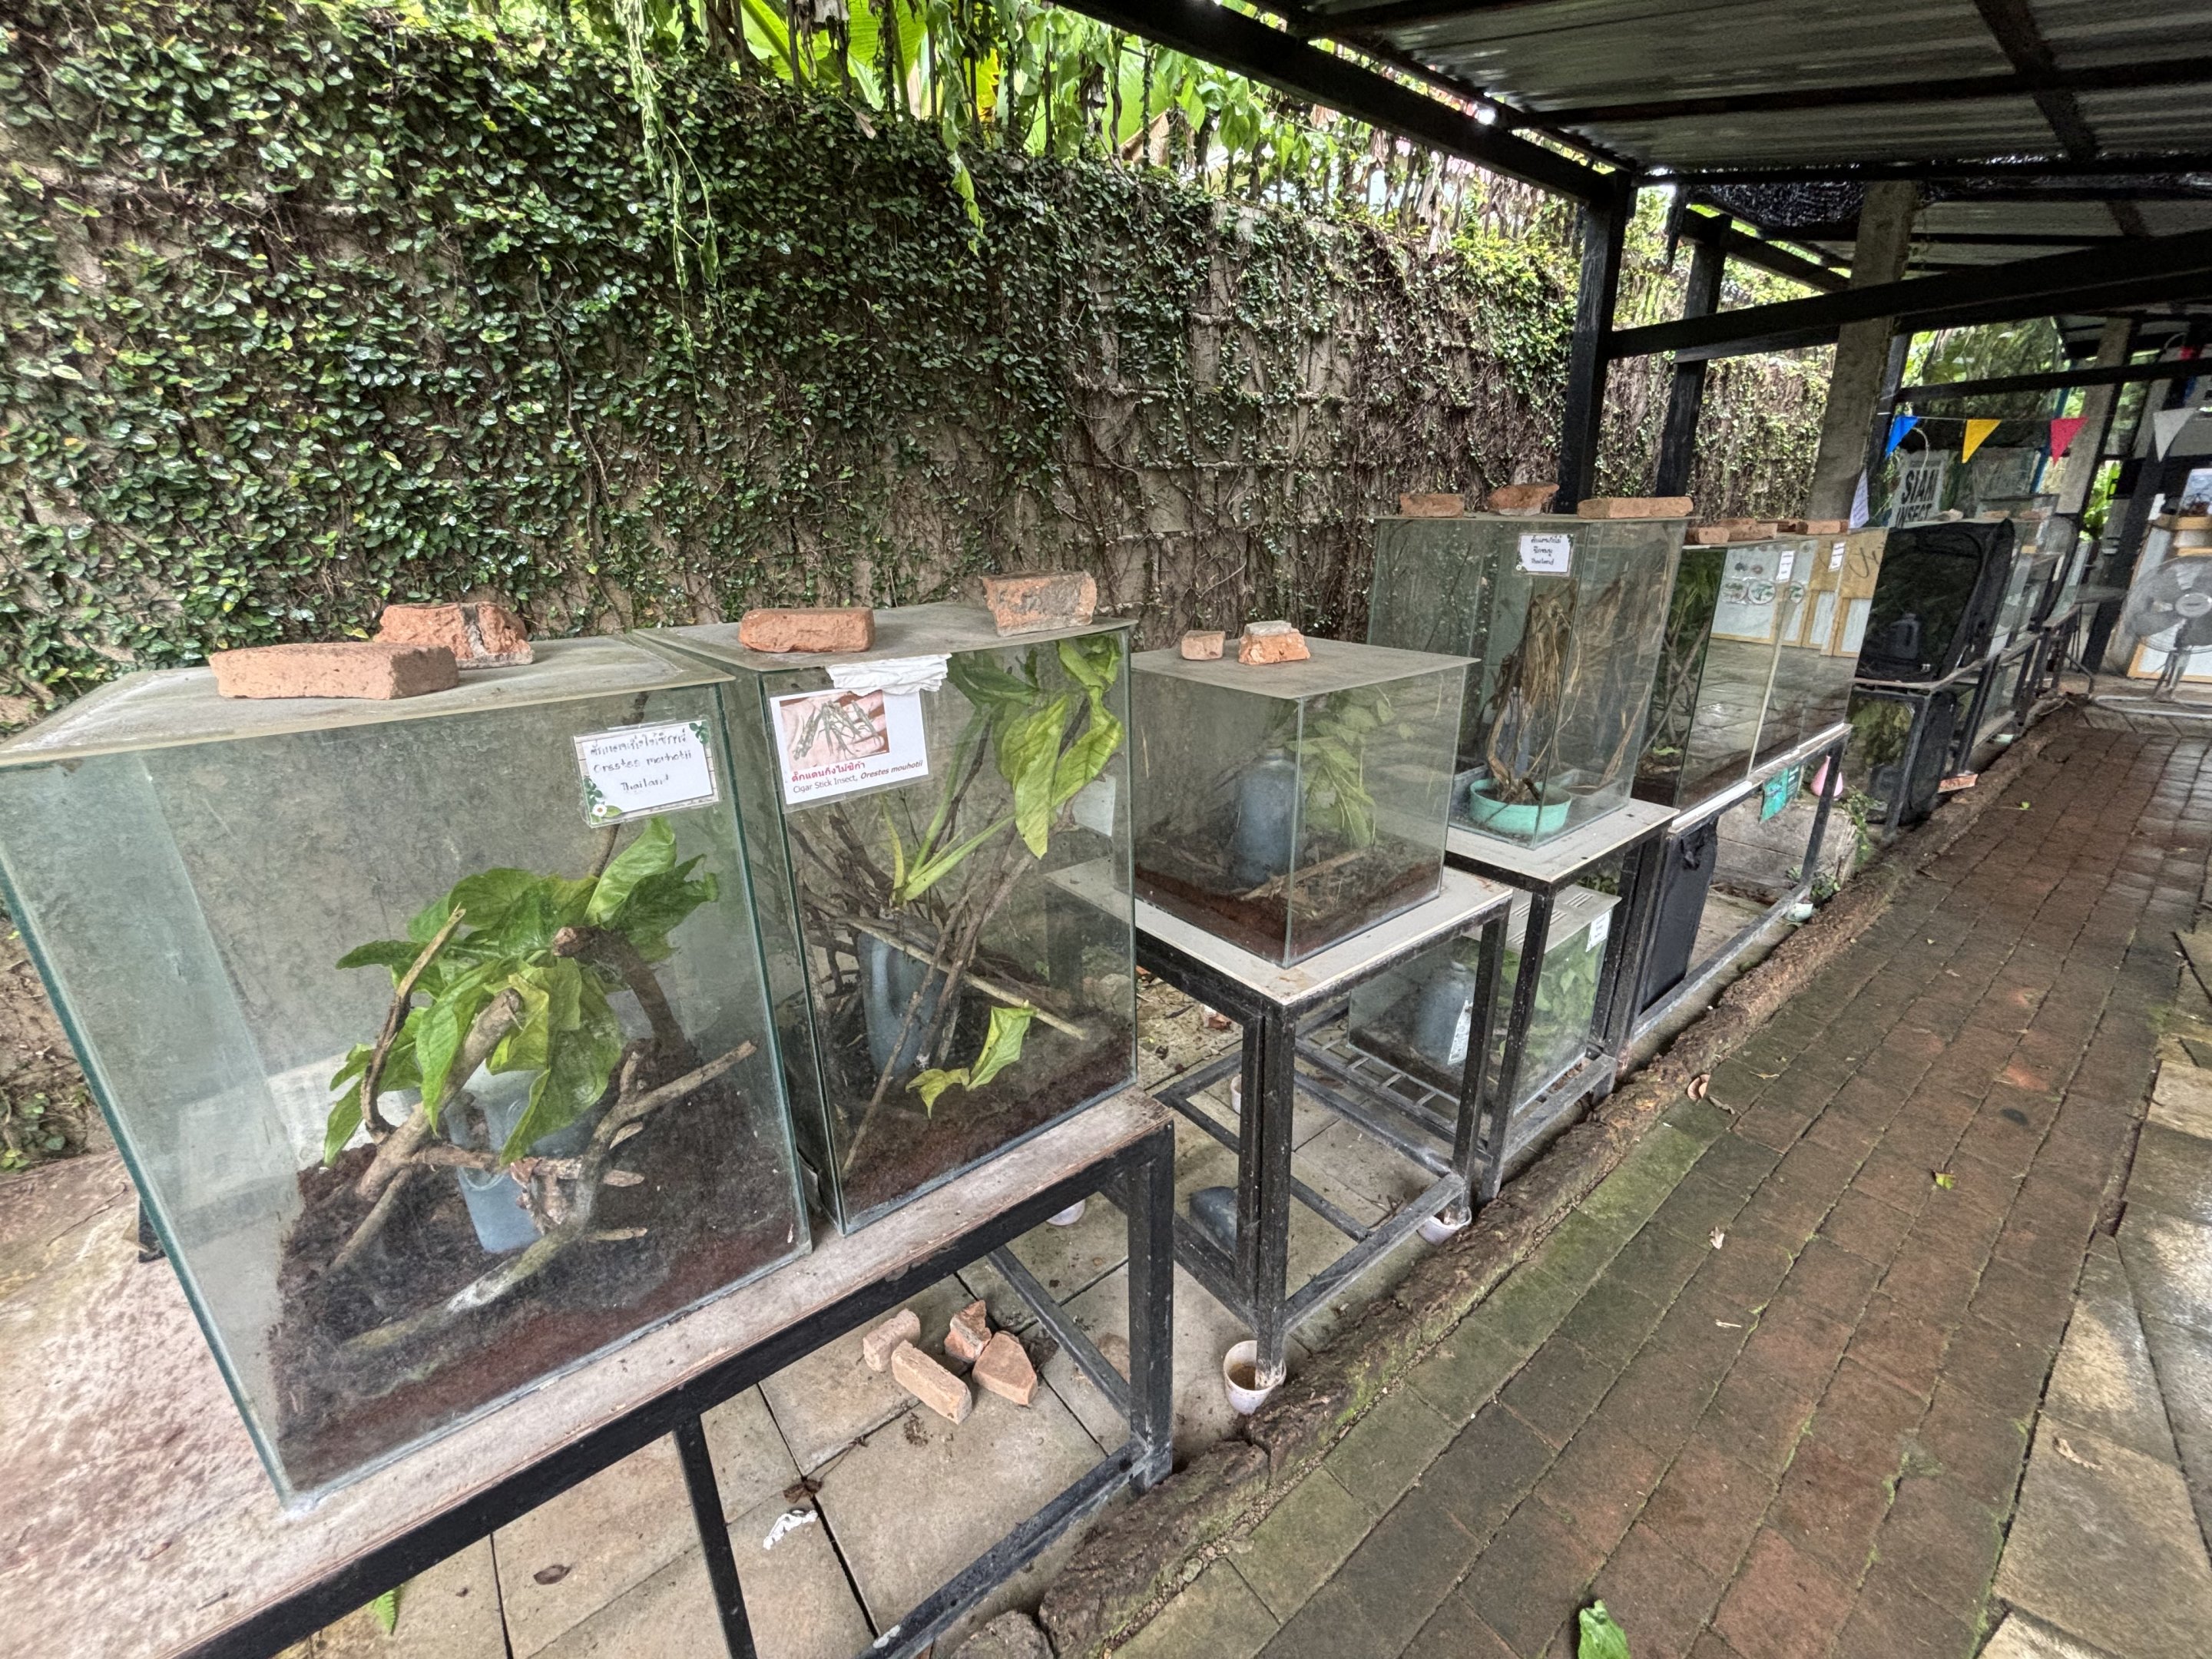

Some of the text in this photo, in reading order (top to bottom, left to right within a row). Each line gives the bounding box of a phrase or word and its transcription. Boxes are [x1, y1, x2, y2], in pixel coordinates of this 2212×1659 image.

[1901, 469, 1940, 504] SIAM
[793, 784, 813, 793] Cigar
[815, 778, 833, 789] Stick
[834, 774, 858, 785] Insect,
[861, 768, 889, 780] Orestes
